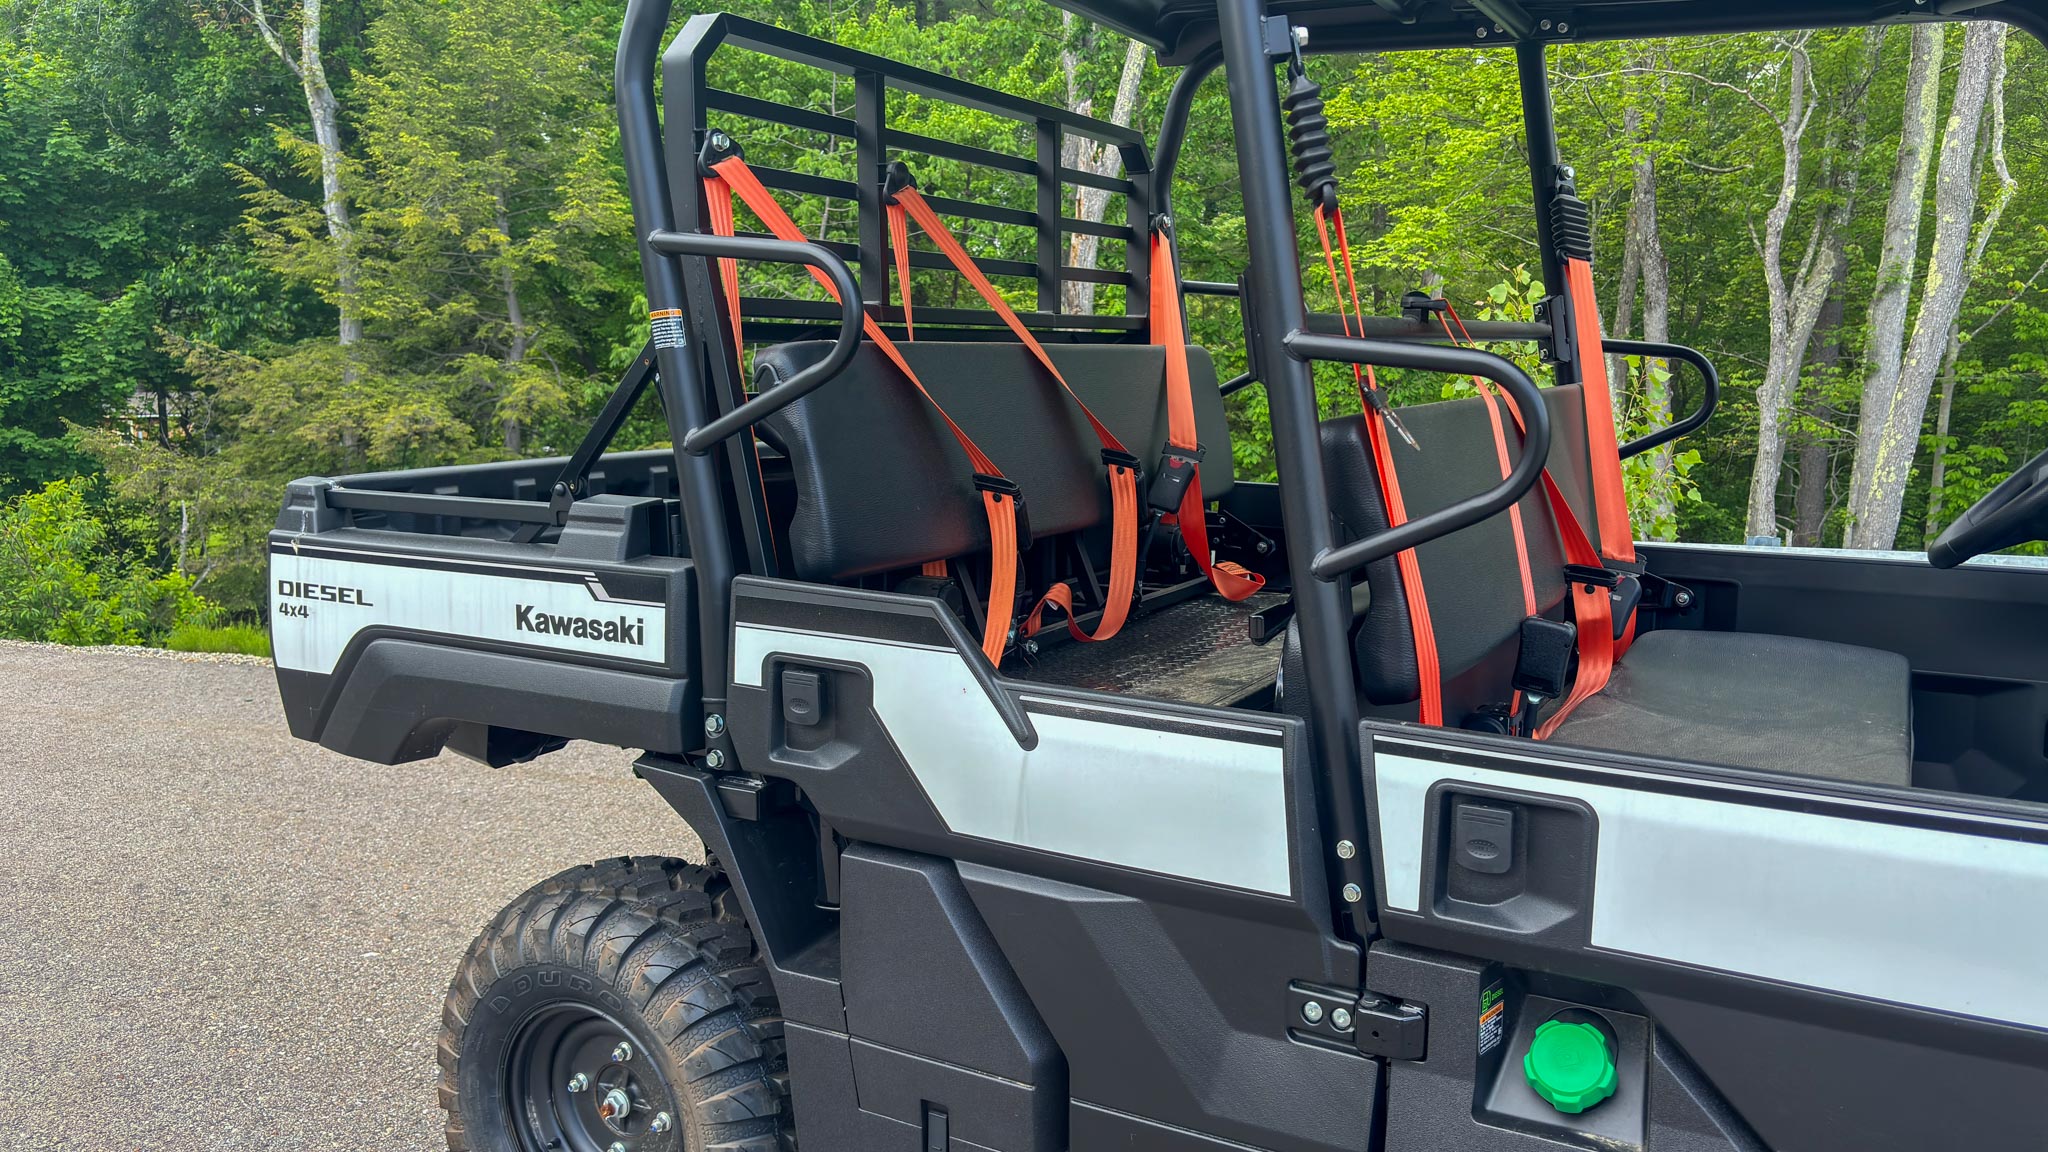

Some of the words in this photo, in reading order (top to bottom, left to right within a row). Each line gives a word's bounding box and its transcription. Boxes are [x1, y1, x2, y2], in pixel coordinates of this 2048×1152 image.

[278, 579, 374, 607] DIESEL
[279, 602, 310, 619] 4x4
[515, 603, 644, 646] Kawasaki
